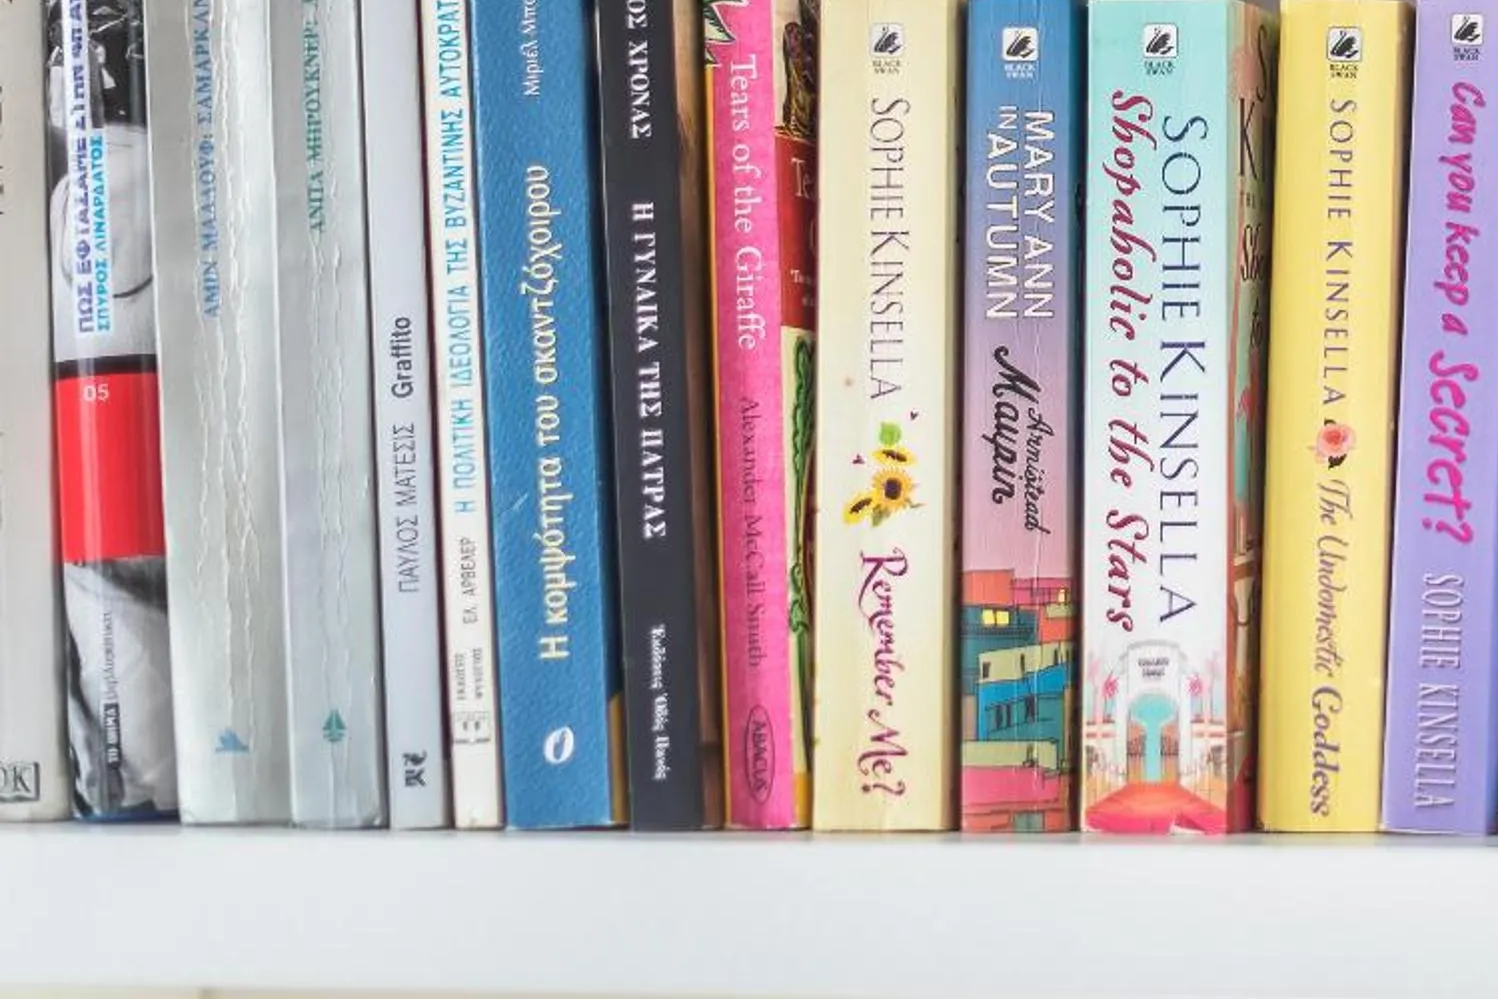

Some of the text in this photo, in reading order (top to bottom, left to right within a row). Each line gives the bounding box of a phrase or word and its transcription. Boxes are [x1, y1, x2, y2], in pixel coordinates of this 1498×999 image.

[441, 109, 467, 228] ΒΥΖΑΝΤΙΝΗΣ
[627, 41, 652, 139] ΧΡΟΝΑΣ
[91, 257, 111, 332] ΣΠΥΡΟΣ
[201, 261, 221, 318] ΑΜΙΝ
[445, 240, 467, 274] ΤΗΣ
[729, 55, 767, 350] Tears of the Giraffe
[869, 98, 910, 400] SOPHIE KINSELLA
[986, 105, 1019, 320] IN AUTUMN
[1023, 110, 1055, 319] MARY ANN
[1323, 99, 1358, 405] SOPHIE KINSELLA
[76, 280, 97, 334] ΠΩΣ
[82, 384, 110, 401] 05
[390, 316, 414, 399] Graffito
[447, 285, 472, 388] ΙΔΕΟΛΟΓΙΑ
[632, 202, 666, 541] Η ΓΥΝΑΙΚΑ ΤΗΣ ΠΑΤΡΑΣ
[1103, 90, 1157, 633] Shopaholic to the Stars
[1159, 115, 1210, 624] SOPHIE KINSELLA
[1422, 82, 1485, 545] Can you keep a Secret?
[452, 400, 476, 490] ΠΟΛΙΤΙΚΗ
[457, 501, 474, 513] Η
[519, 165, 576, 659] Η κομψότητα του σκαντζόχοιρου
[982, 346, 1042, 504] Maupin
[1024, 407, 1055, 535] Armistead
[391, 422, 420, 594] ΠΑΥΛΟΣ ΜΑΤΕΣΙΣ
[741, 397, 766, 670] Alexander McCall Smith
[857, 547, 909, 797] Remember Me?
[1310, 478, 1354, 817] The Undomestic Goddess
[1412, 573, 1465, 810] SOPHIE KINSELLA
